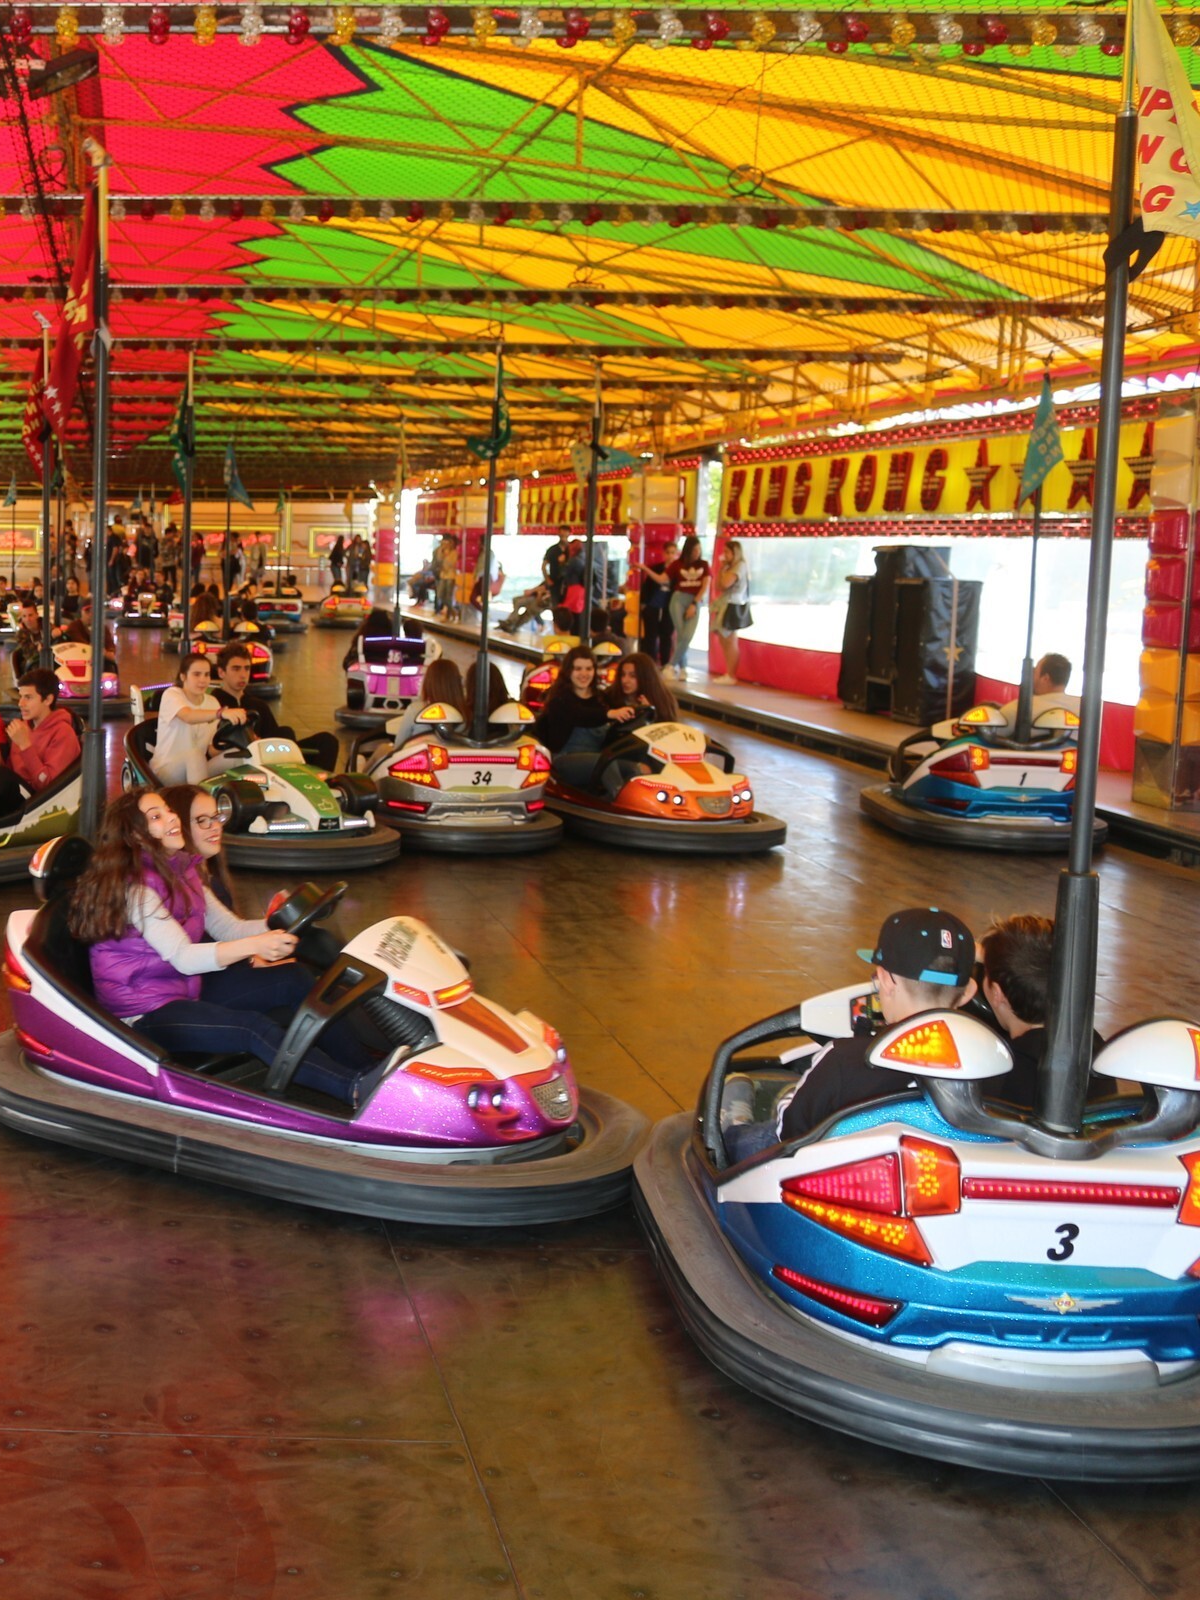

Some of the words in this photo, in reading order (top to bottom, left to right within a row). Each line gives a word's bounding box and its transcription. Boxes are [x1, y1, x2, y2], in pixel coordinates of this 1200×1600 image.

[726, 462, 813, 520] KING
[823, 448, 949, 517] KONG
[471, 770, 493, 786] 34
[1019, 771, 1028, 787] 1
[1046, 1222, 1080, 1262] 3
